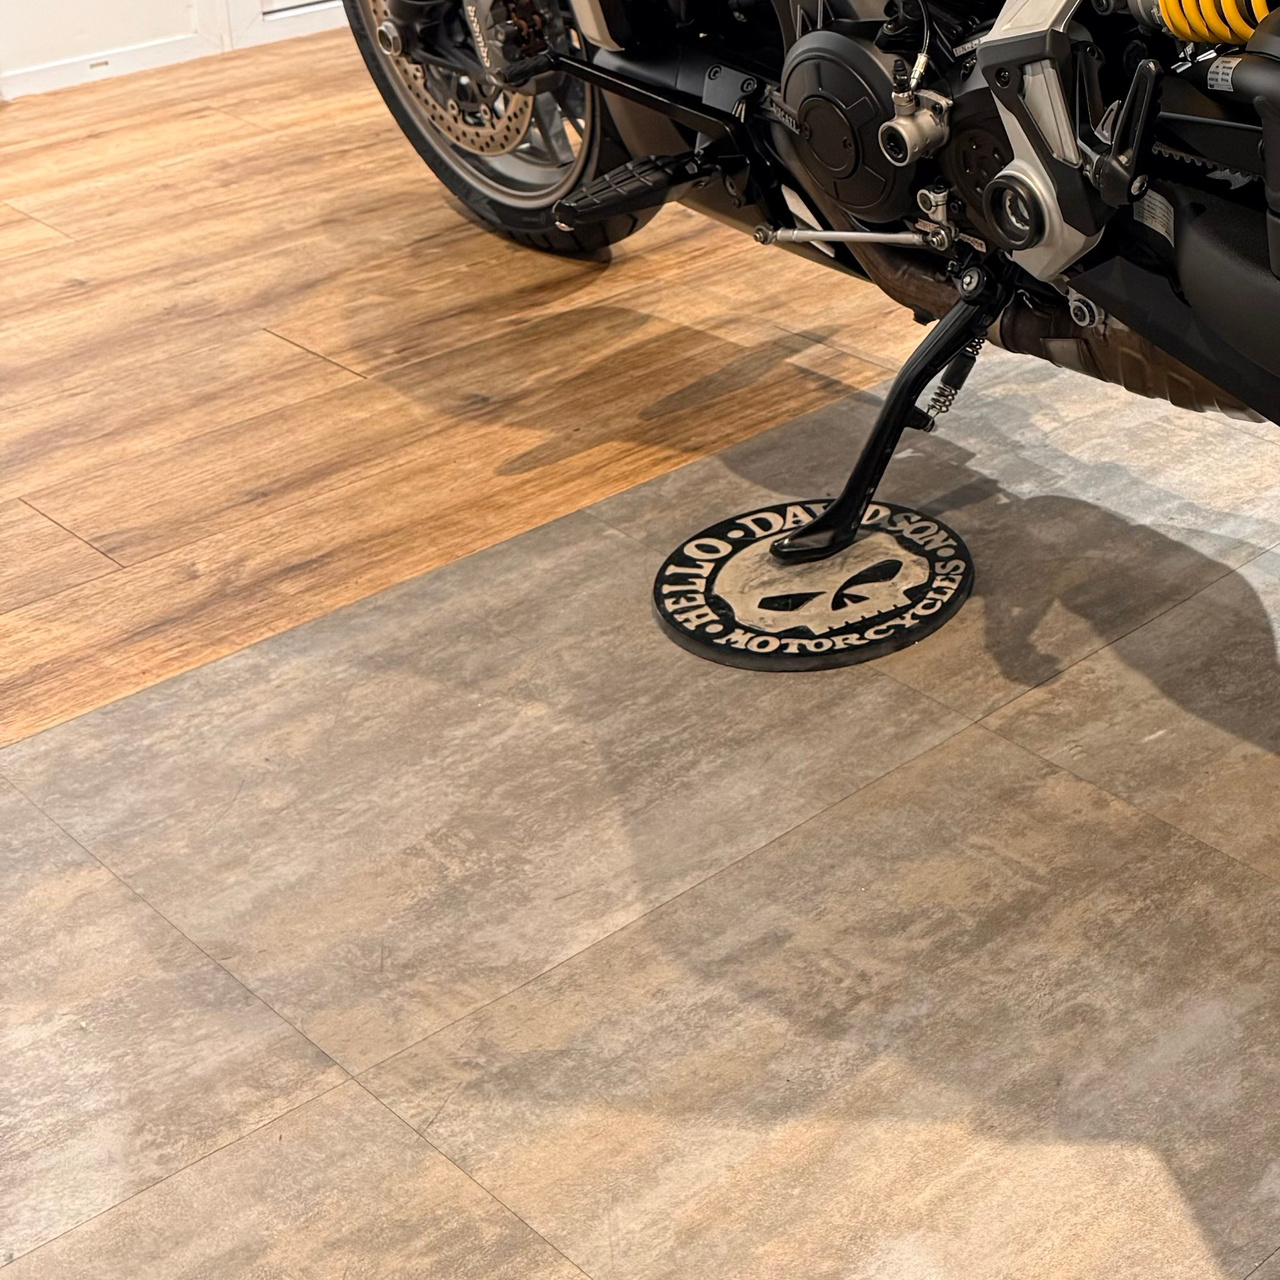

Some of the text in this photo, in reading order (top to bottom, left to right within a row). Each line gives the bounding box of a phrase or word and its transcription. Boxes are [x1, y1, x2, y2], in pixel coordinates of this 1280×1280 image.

[467, 5, 491, 69] brembo
[661, 503, 966, 655] HELLO DADSON MOTORCYCLES
